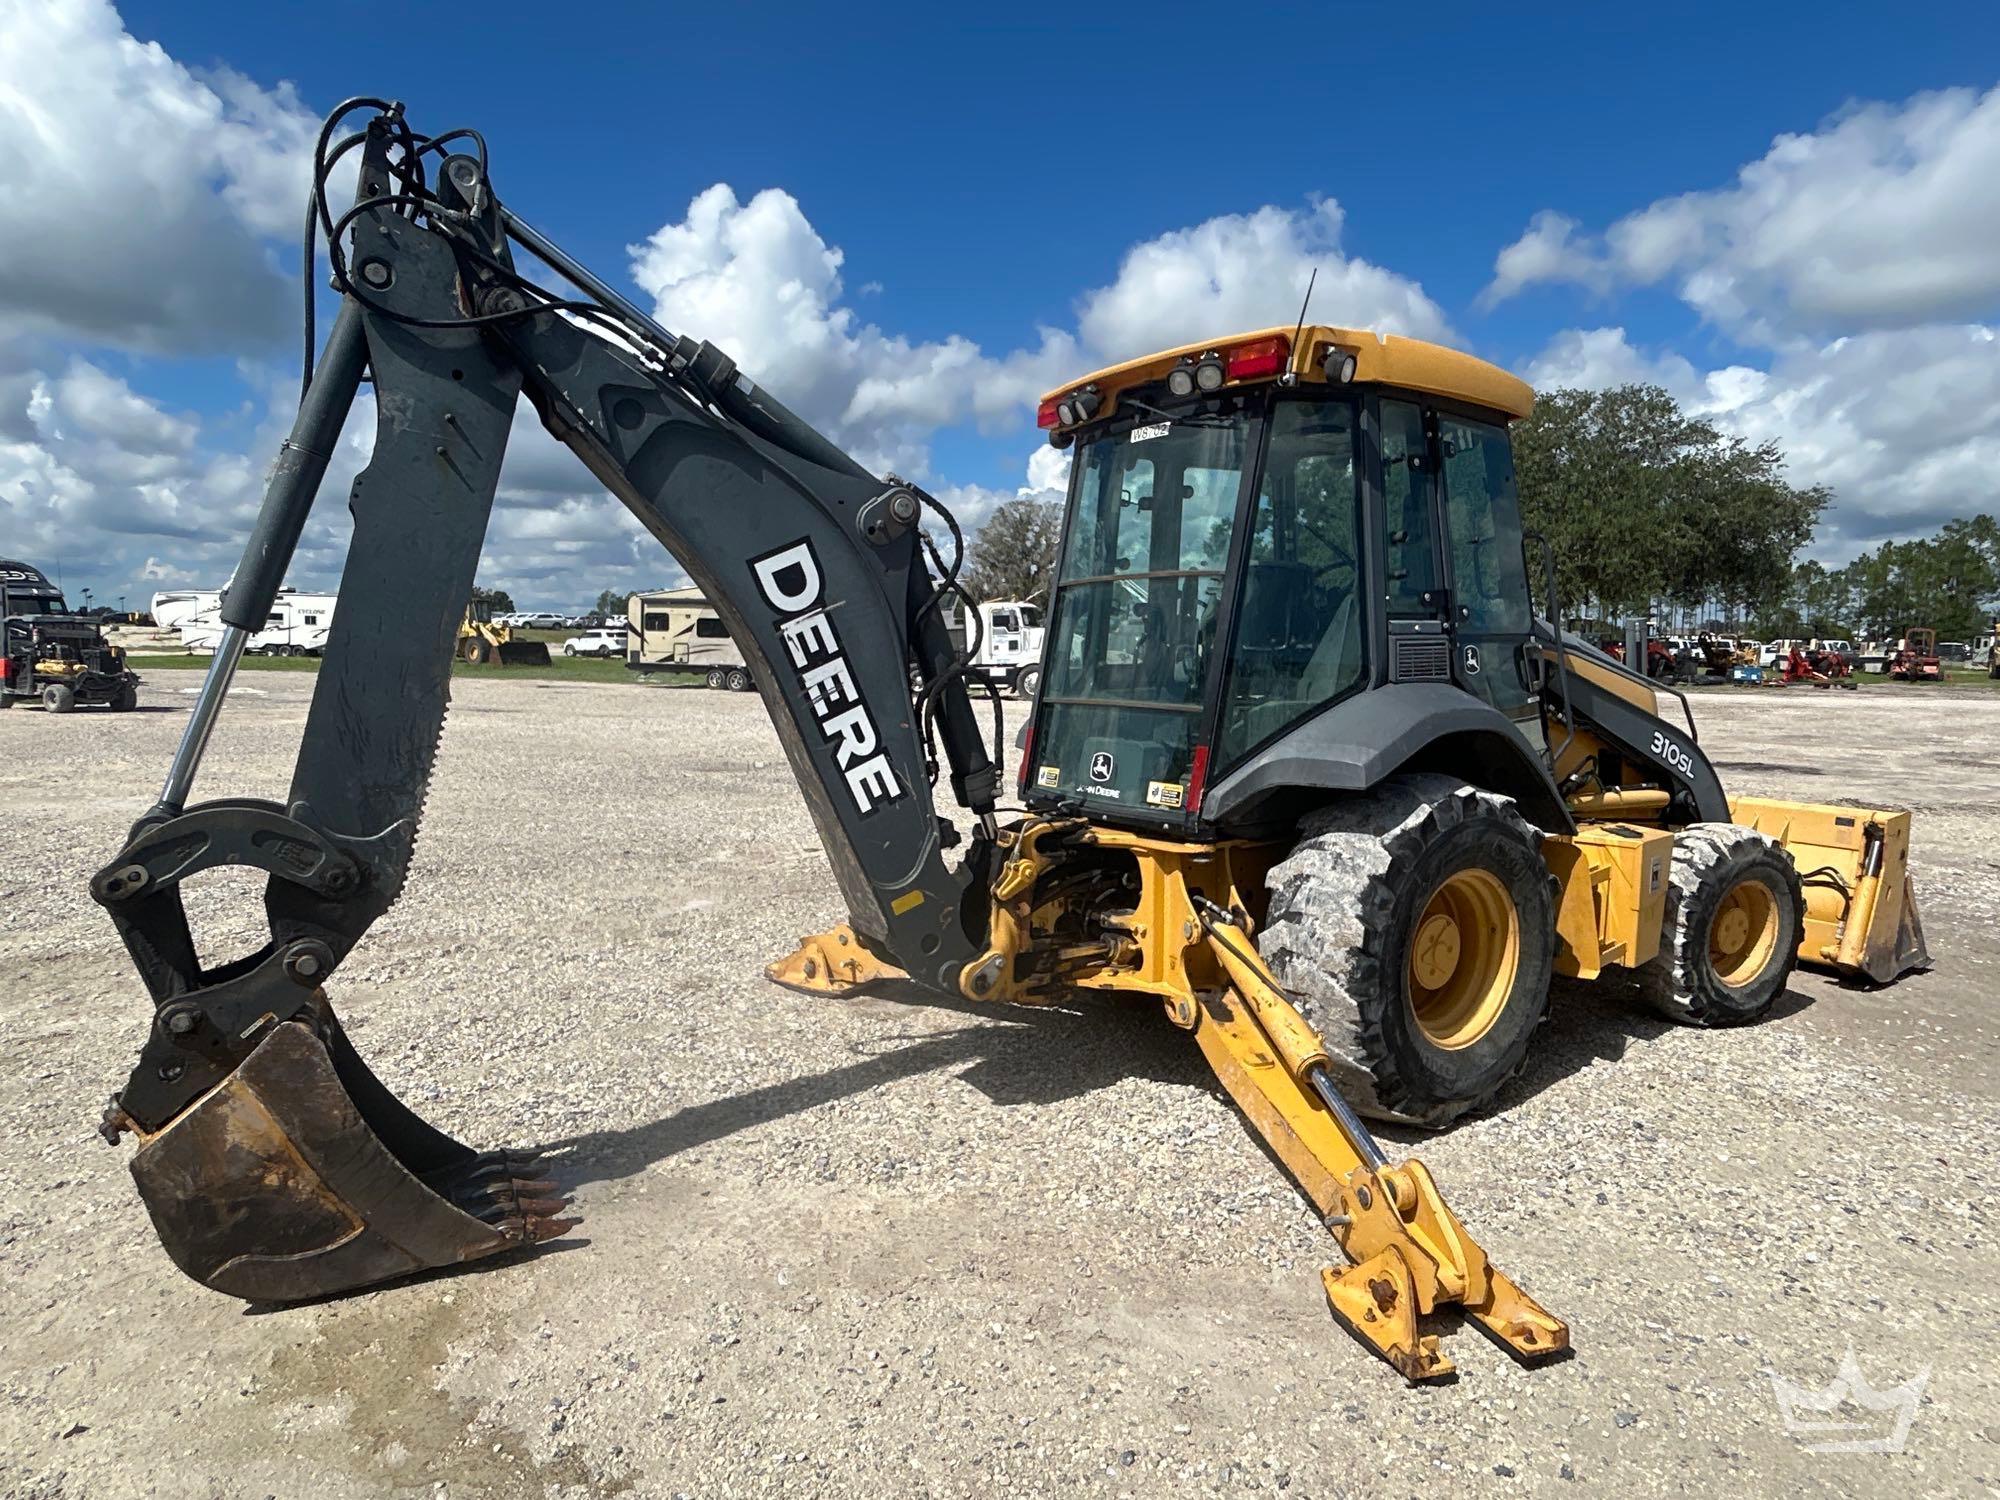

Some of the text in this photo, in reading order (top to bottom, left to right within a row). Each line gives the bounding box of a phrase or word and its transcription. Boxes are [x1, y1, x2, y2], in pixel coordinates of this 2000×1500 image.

[753, 542, 902, 815] DEERE
[1650, 730, 1695, 779] 310SL
[1095, 785, 1120, 799] DEERE
